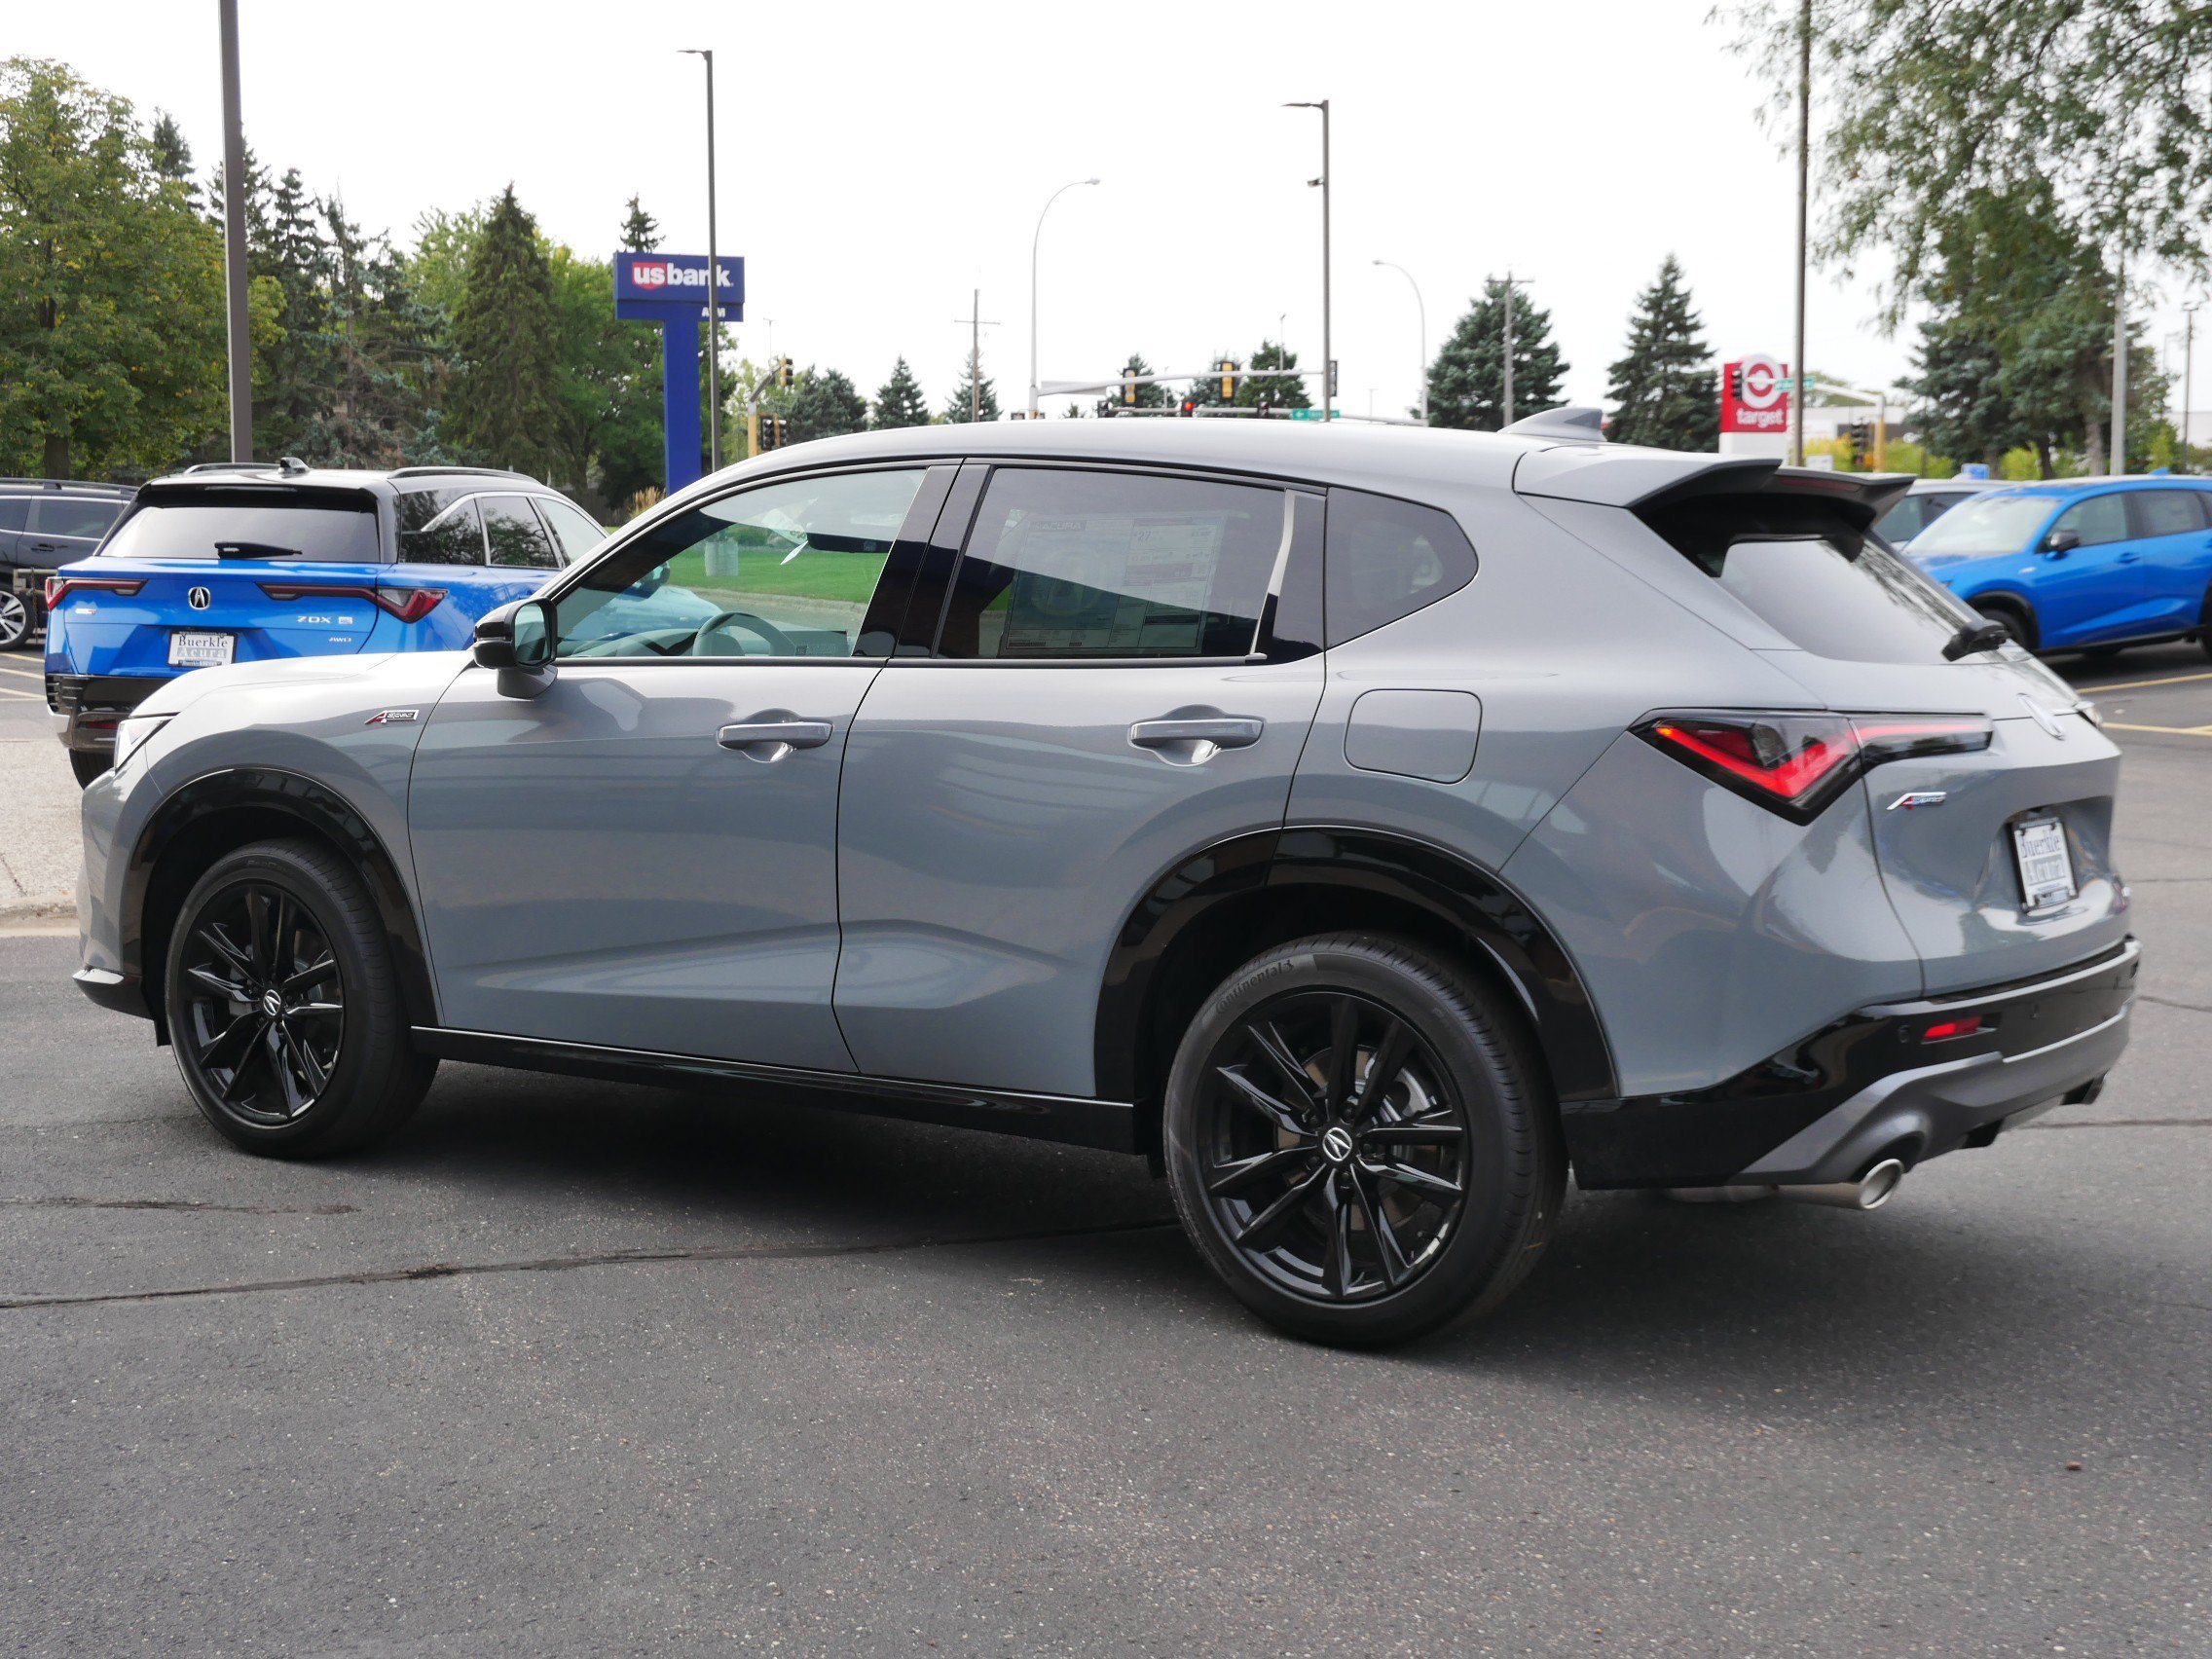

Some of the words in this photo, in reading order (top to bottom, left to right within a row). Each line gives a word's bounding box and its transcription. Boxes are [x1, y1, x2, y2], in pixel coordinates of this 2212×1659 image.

[701, 307, 726, 317] AM
[1736, 408, 1784, 428] target
[297, 615, 331, 624] ZDX
[178, 636, 228, 647] Buerkle
[177, 647, 226, 658] Acura
[1216, 962, 1283, 1014] Continental
